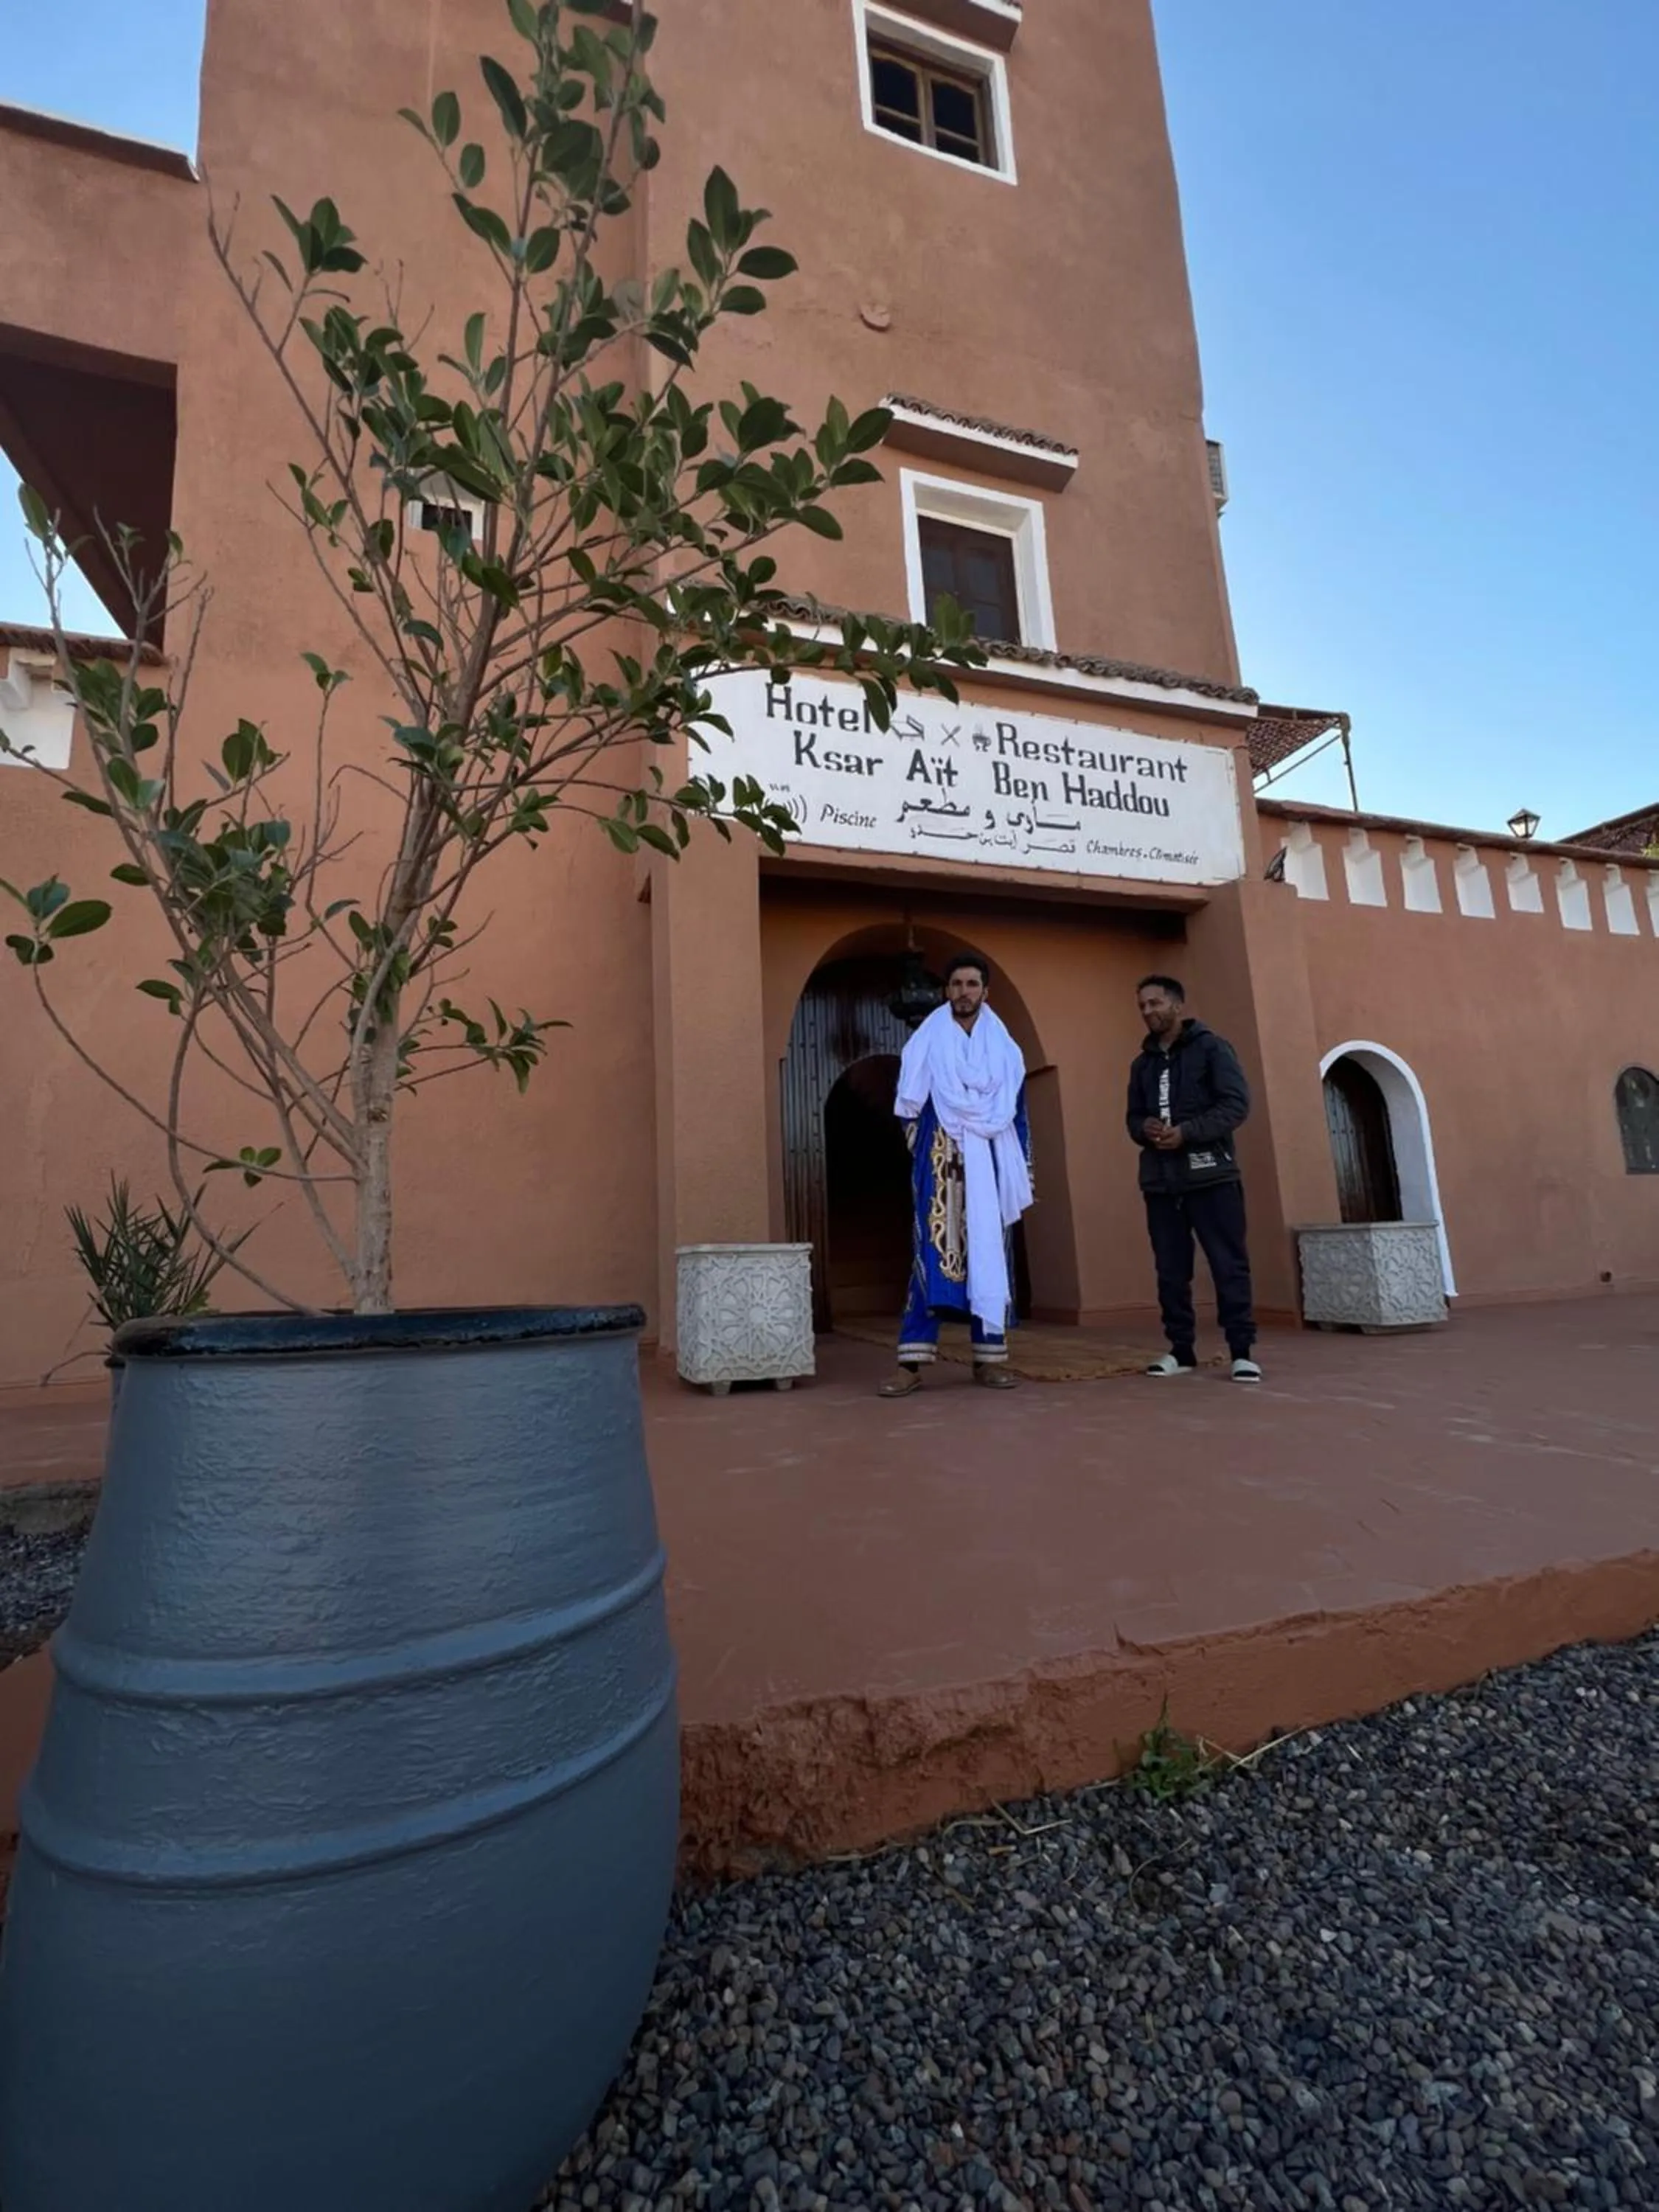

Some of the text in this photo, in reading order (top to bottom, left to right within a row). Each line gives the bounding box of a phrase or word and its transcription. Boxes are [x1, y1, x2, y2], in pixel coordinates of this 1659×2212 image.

[765, 681, 1188, 783] Hotel Restaurant
[793, 729, 1170, 817] Ksar Aït Ben Haddou
[820, 803, 877, 828] Piscine
[984, 809, 996, 830] و
